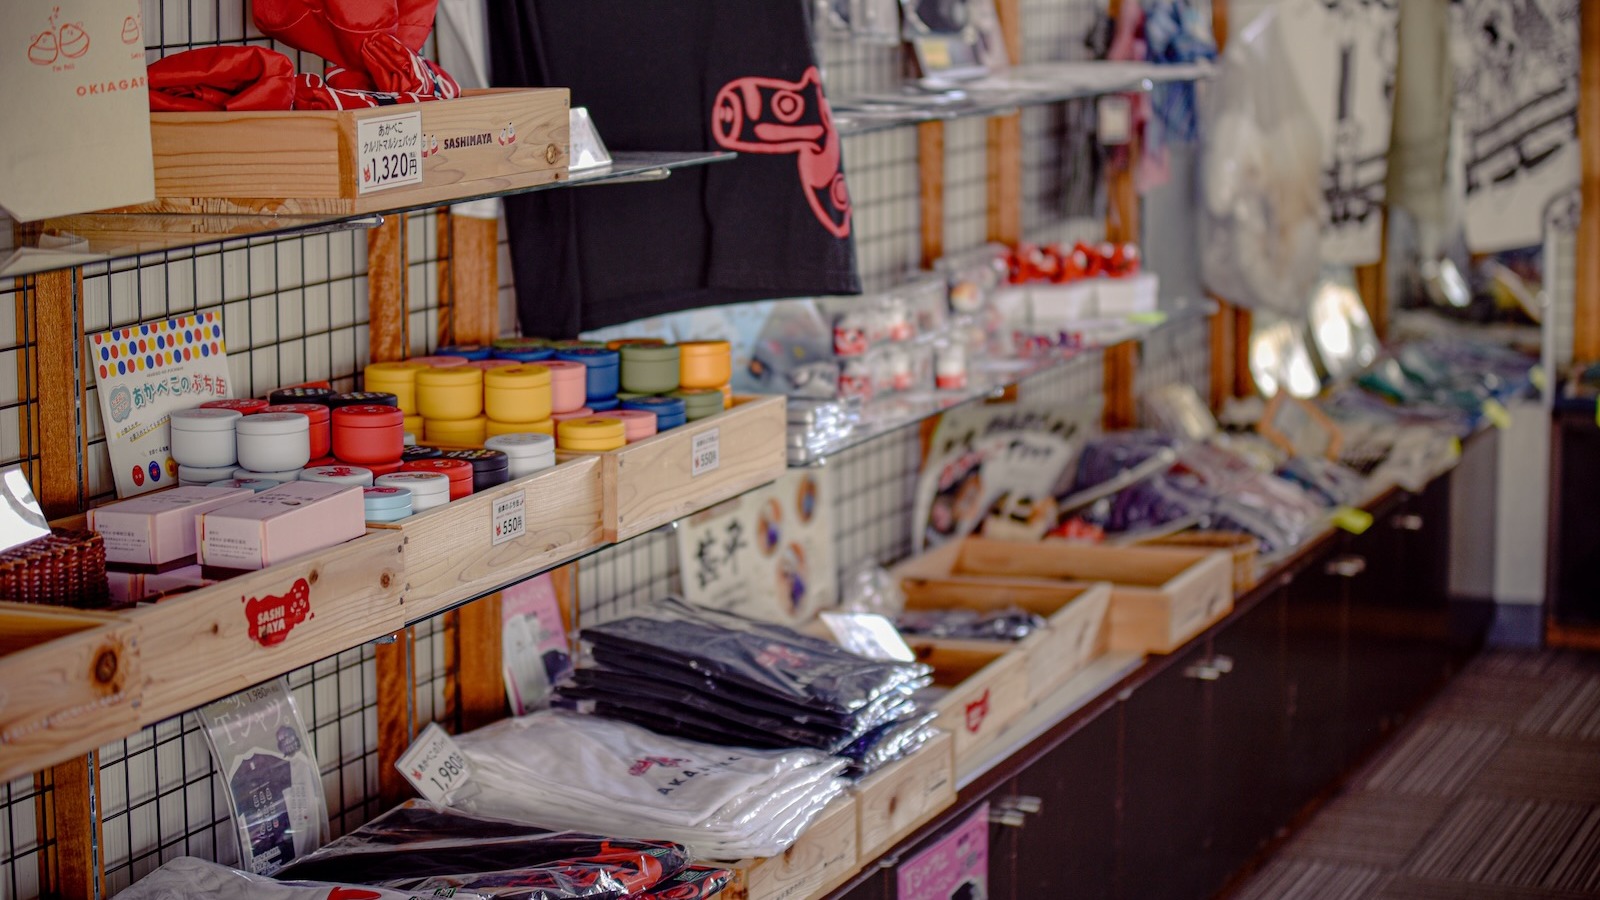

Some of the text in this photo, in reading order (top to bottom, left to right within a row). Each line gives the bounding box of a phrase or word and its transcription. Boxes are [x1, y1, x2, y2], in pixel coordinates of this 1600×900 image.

[378, 122, 403, 137] あかべこ
[444, 132, 493, 150] SASHIMAYA
[371, 152, 417, 184] 1,320円
[257, 605, 285, 626] SASHI
